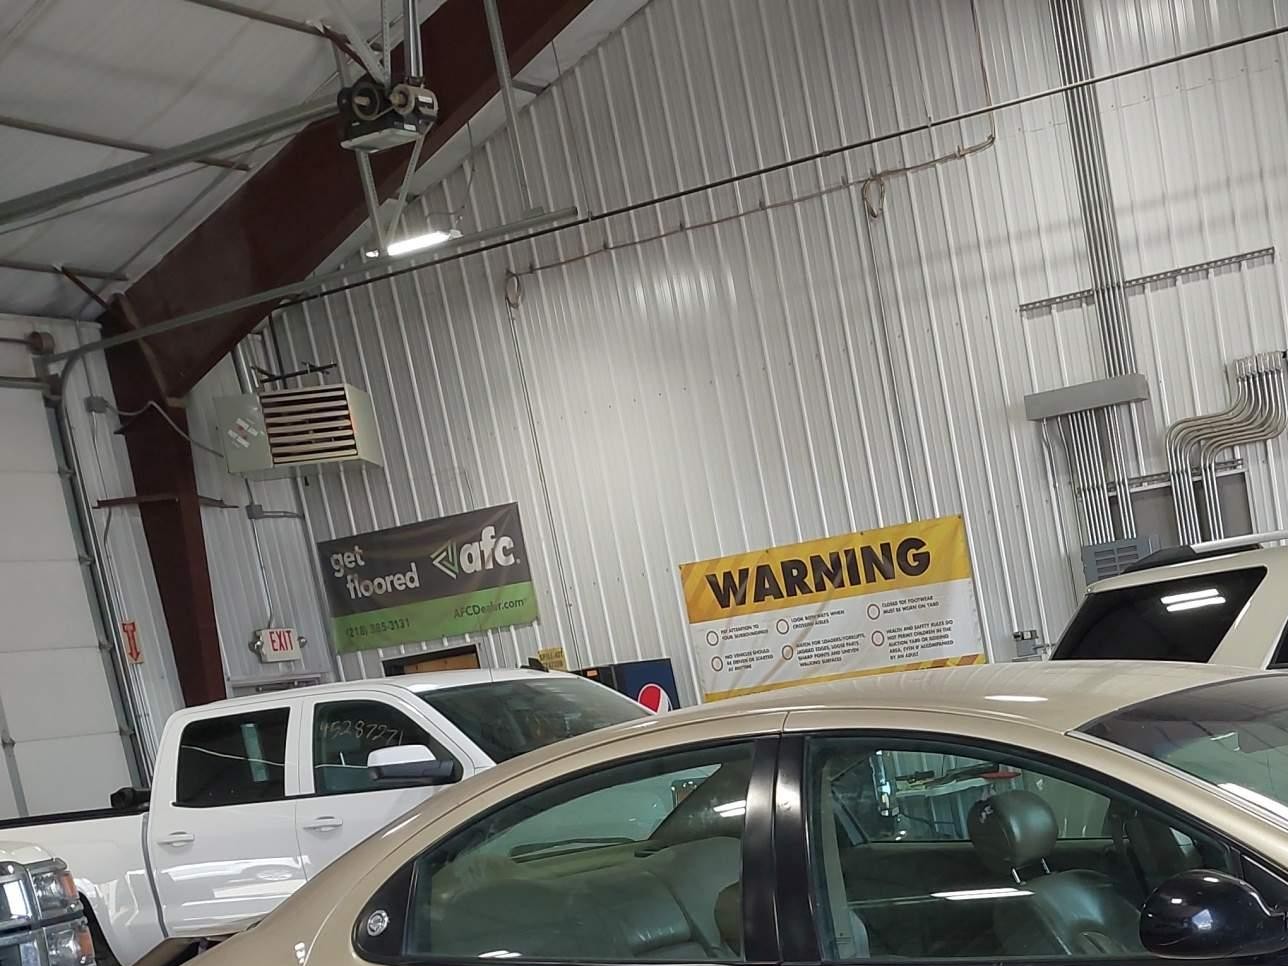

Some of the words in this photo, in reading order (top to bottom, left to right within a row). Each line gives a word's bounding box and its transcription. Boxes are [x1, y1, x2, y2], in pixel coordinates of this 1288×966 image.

[330, 546, 365, 577] get
[459, 526, 515, 574] afc
[346, 563, 420, 599] floored
[705, 537, 931, 609] WARNING
[269, 630, 293, 651] EXIT
